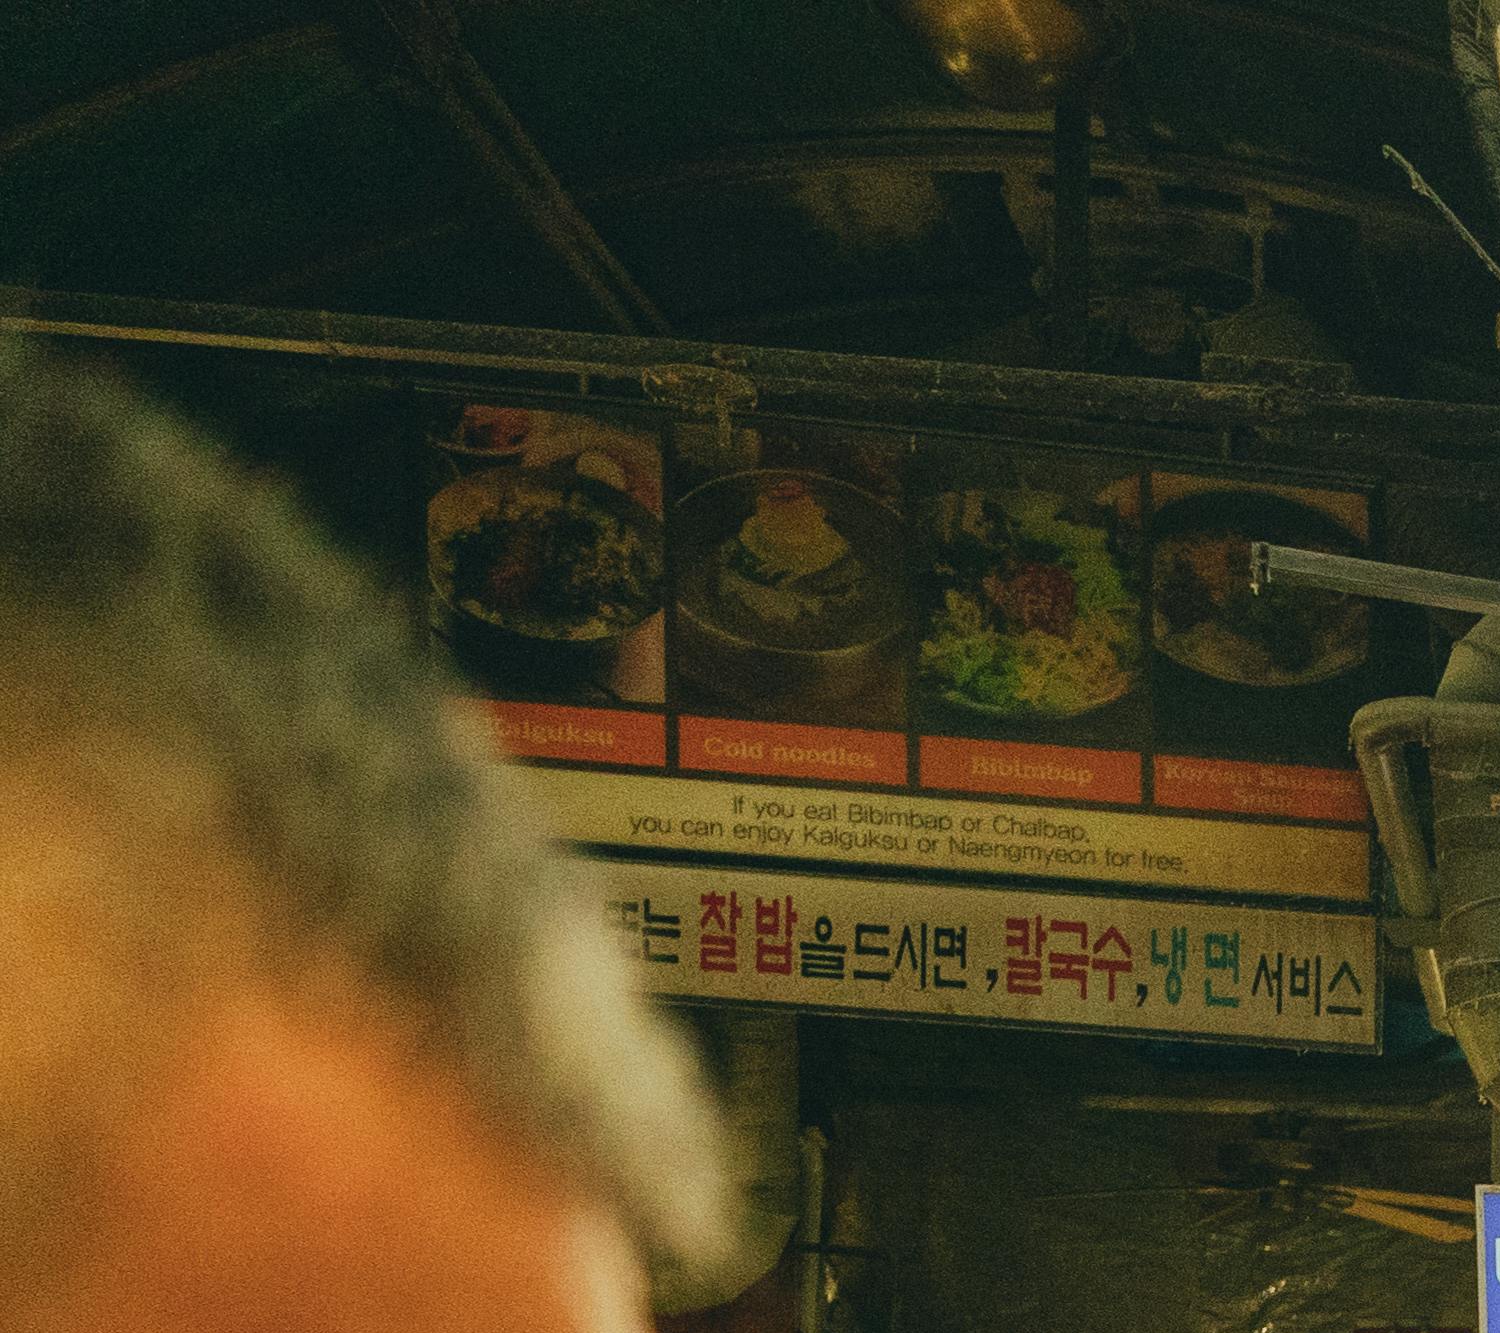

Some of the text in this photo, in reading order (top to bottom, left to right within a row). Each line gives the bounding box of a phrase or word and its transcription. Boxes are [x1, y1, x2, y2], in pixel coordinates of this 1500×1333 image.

[704, 735, 877, 769] Cold noodles
[970, 754, 1095, 786] Bibimbap
[732, 796, 1091, 842] If you eat Bibimbap or Chalbap,
[629, 814, 1190, 875] you can enjoy Kalguksu or Naengmyeon for free.
[1150, 926, 1242, 1008] 냉면
[1253, 951, 1364, 1016] 서비스
